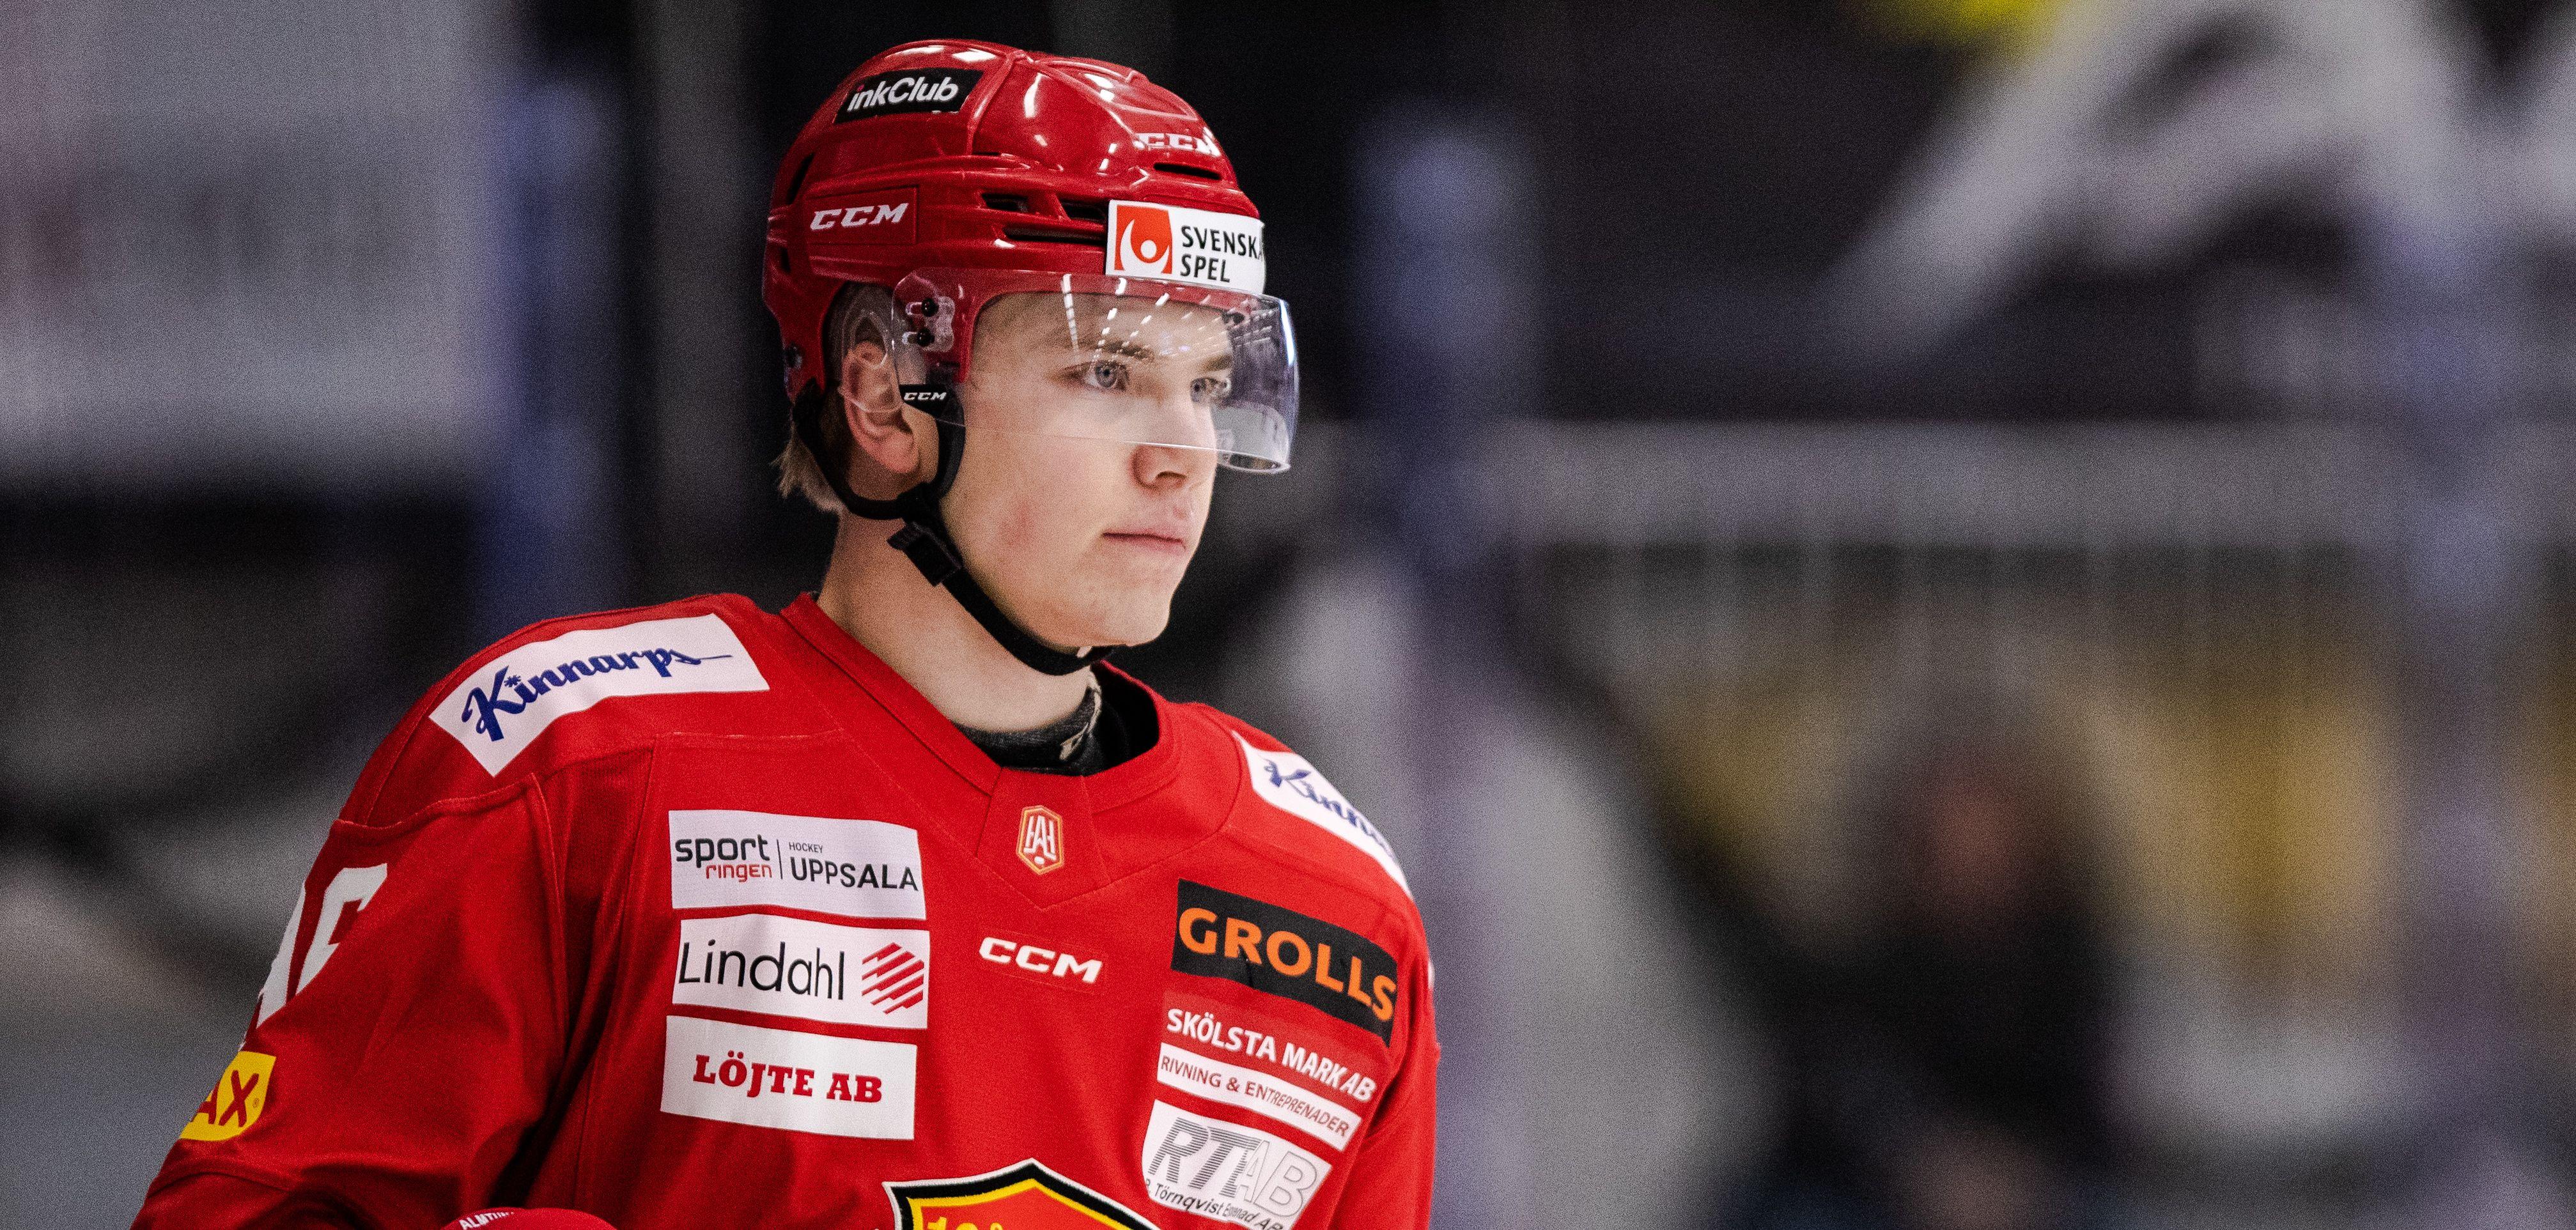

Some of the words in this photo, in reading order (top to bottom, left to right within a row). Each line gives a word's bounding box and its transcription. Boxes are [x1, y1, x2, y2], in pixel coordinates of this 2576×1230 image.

[847, 77, 959, 111] inkClub
[809, 203, 909, 231] CCM
[1181, 225, 1263, 261] SVENSK
[1180, 254, 1230, 282] SPEL
[903, 392, 947, 401] CCM
[461, 647, 733, 742] Kinnarps
[674, 834, 770, 868] sport
[789, 842, 823, 854] HOCKEY
[705, 863, 772, 882] ringen
[791, 857, 919, 891] UPPSALA
[678, 939, 845, 1001] Lindahl
[979, 934, 1103, 983] CCM
[1179, 907, 1397, 1021] GROLLS
[1167, 1008, 1277, 1063] SKÖLSTA
[1281, 1042, 1347, 1089] MARK
[1339, 1072, 1377, 1103] AB
[693, 1050, 815, 1098] LÖJTE
[826, 1073, 883, 1103] AB
[1161, 1055, 1222, 1088] RIVNING
[1227, 1077, 1240, 1092] &
[1244, 1080, 1350, 1137] ENTREPRENADER
[1154, 1183, 1224, 1217] Törnqvist
